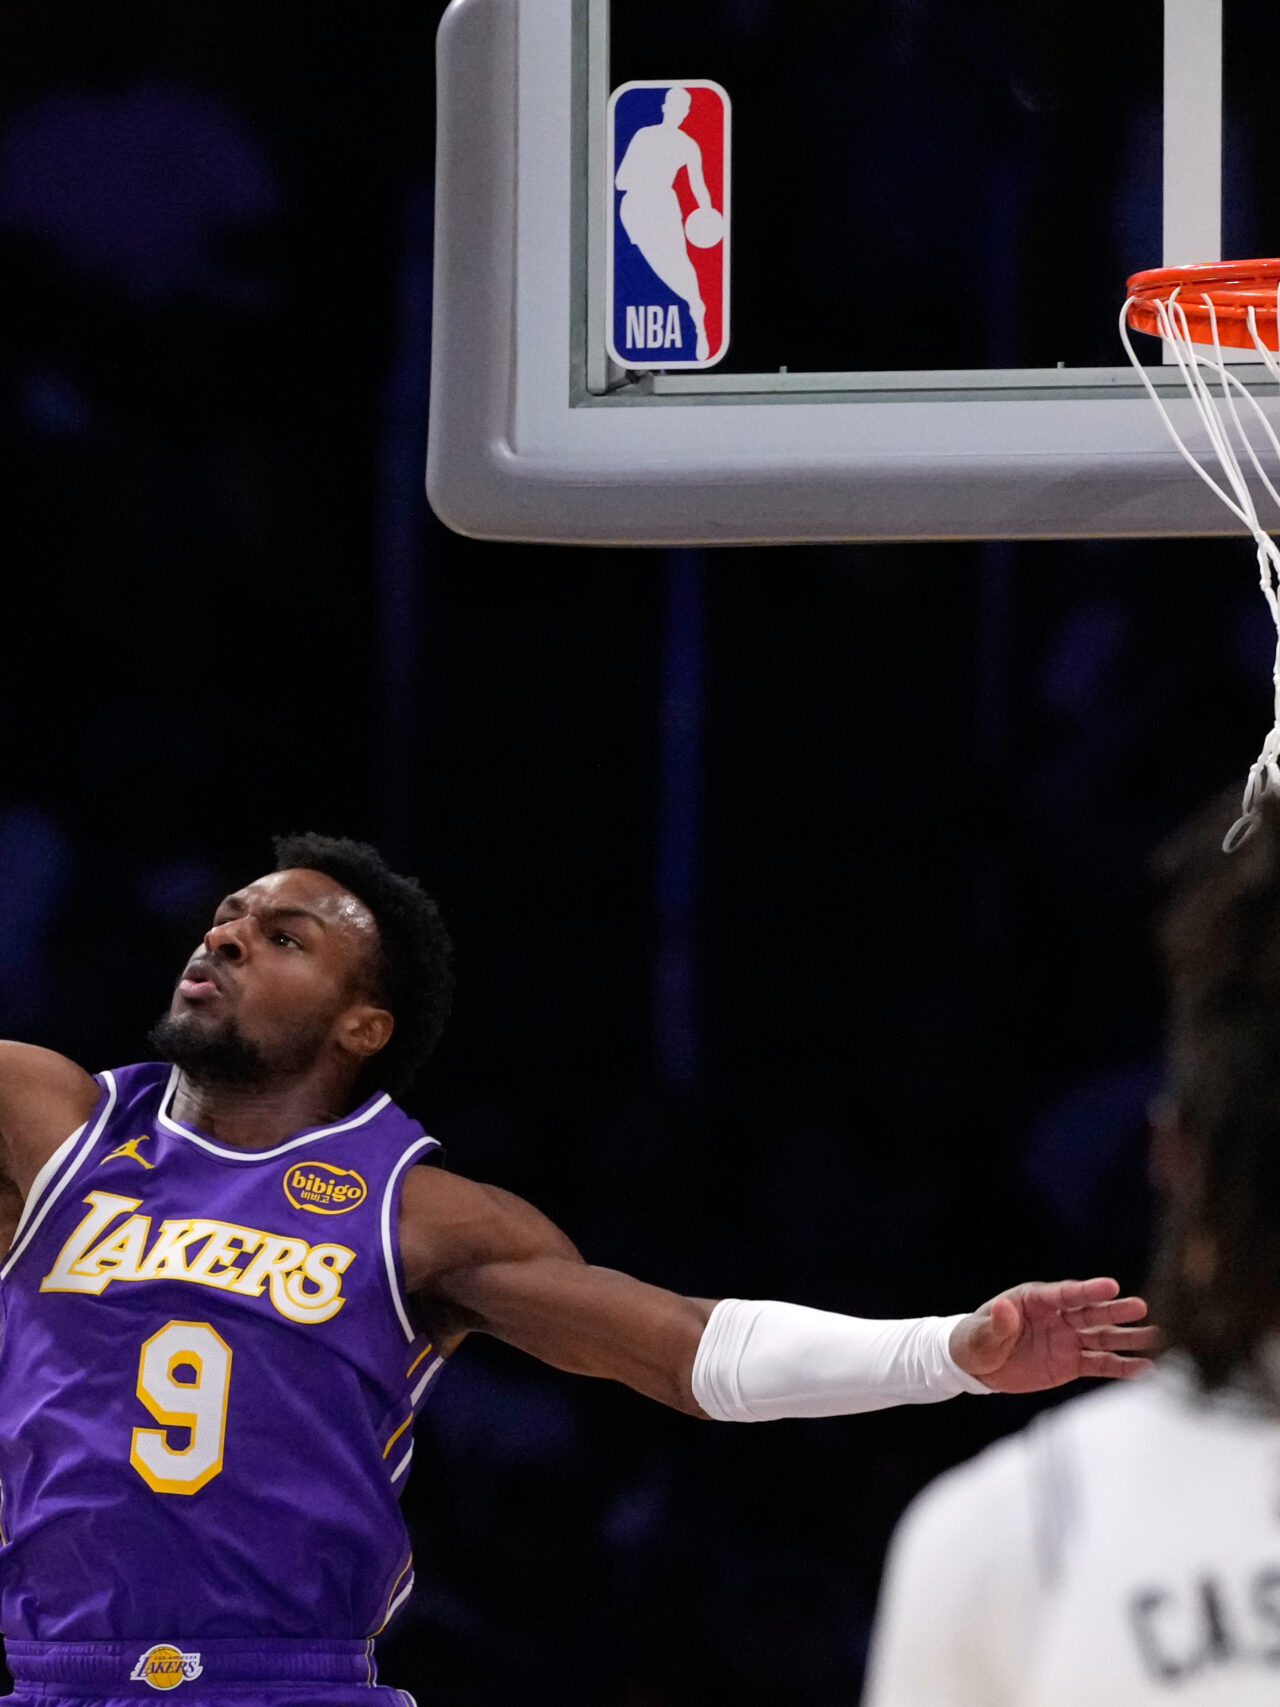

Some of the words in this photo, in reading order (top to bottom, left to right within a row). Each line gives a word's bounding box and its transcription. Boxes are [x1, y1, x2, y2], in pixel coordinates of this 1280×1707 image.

[626, 305, 682, 349] NBA
[292, 1170, 362, 1202] bibigo
[40, 1191, 357, 1324] LAKERS
[130, 1320, 233, 1495] 9
[136, 1656, 198, 1678] LAKERS
